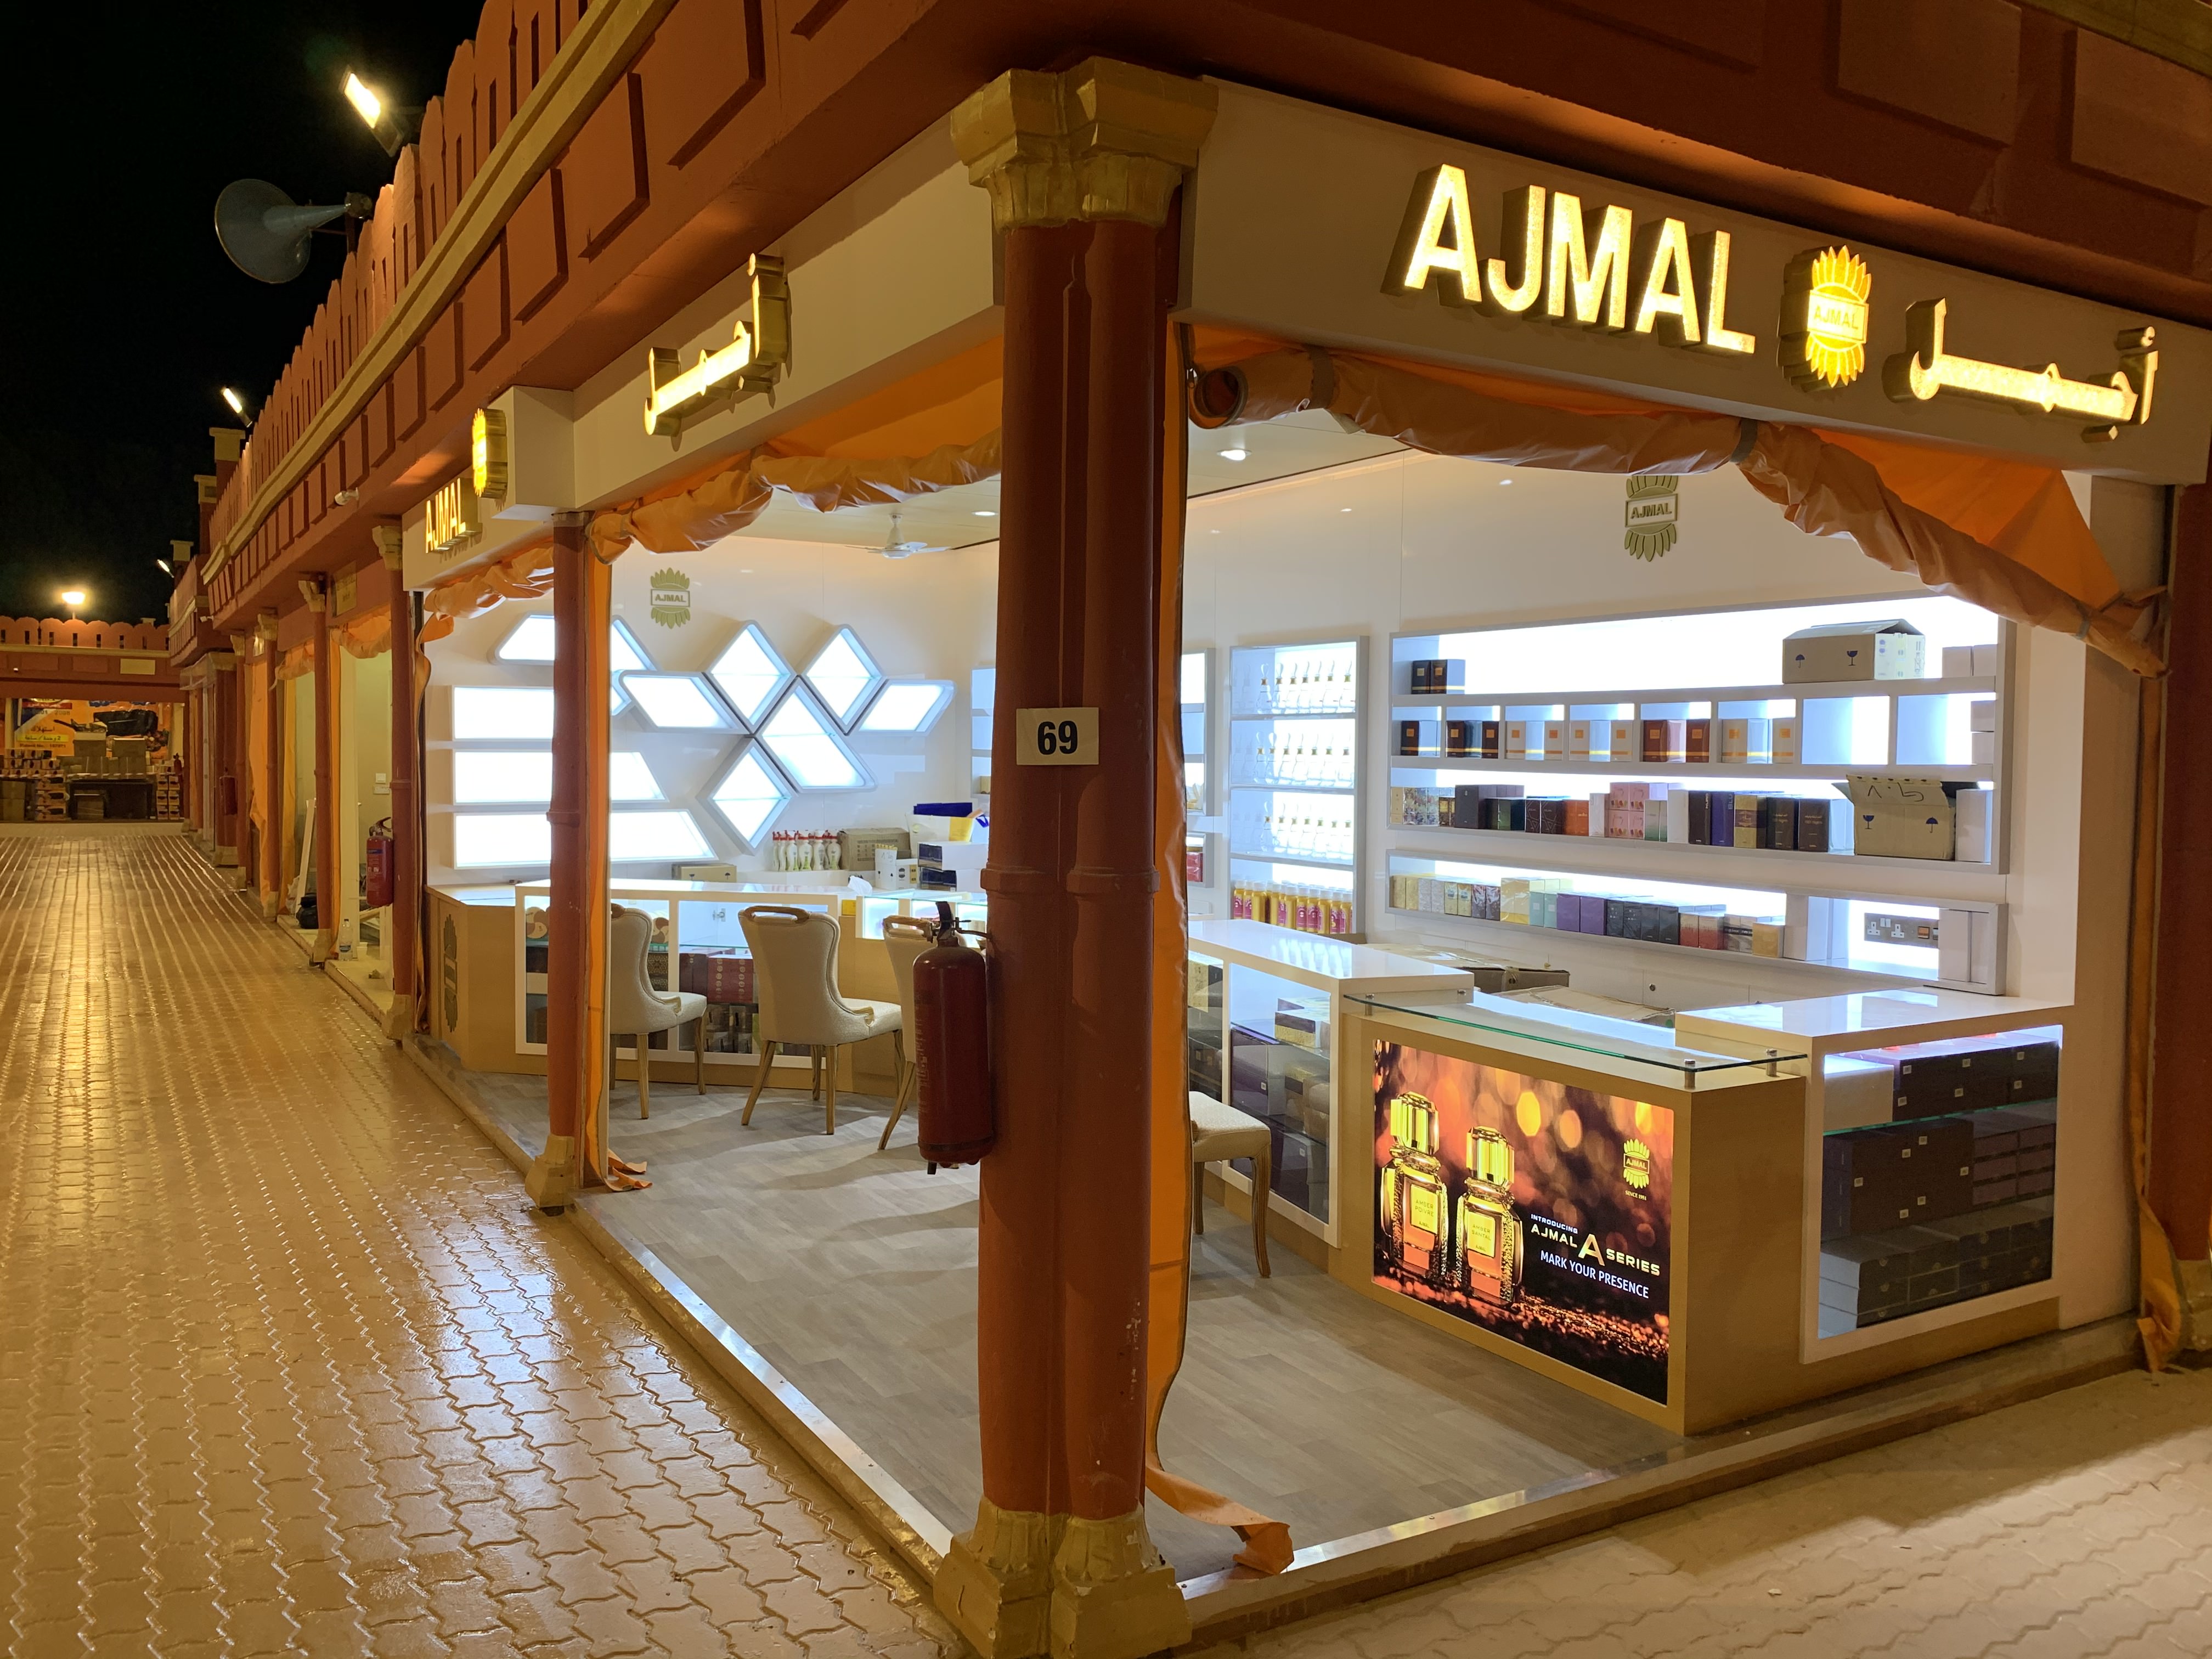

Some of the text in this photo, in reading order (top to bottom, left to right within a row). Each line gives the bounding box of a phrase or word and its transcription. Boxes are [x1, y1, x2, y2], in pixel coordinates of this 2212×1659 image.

[1402, 163, 1756, 355] AJMAL
[1814, 306, 1859, 330] AJMAL
[1907, 296, 2158, 441] أجمل
[425, 478, 466, 554] AJMAL
[1630, 503, 1672, 519] AJMAL
[654, 594, 686, 602] AJMAL
[1037, 720, 1079, 756] 69
[1626, 1158, 1647, 1170] AJMAL
[1625, 1190, 1638, 1198] SINCE
[1415, 1199, 1434, 1209] AMBER
[1415, 1206, 1434, 1217] POIVRE
[1472, 1224, 1491, 1233] AMBER
[1531, 1214, 1578, 1234] INTRODUCING
[1471, 1230, 1491, 1241] SANTAL
[1531, 1223, 1661, 1277] AJMAL A SERIES
[1541, 1250, 1649, 1299] MARK YOUR PRESENCE
